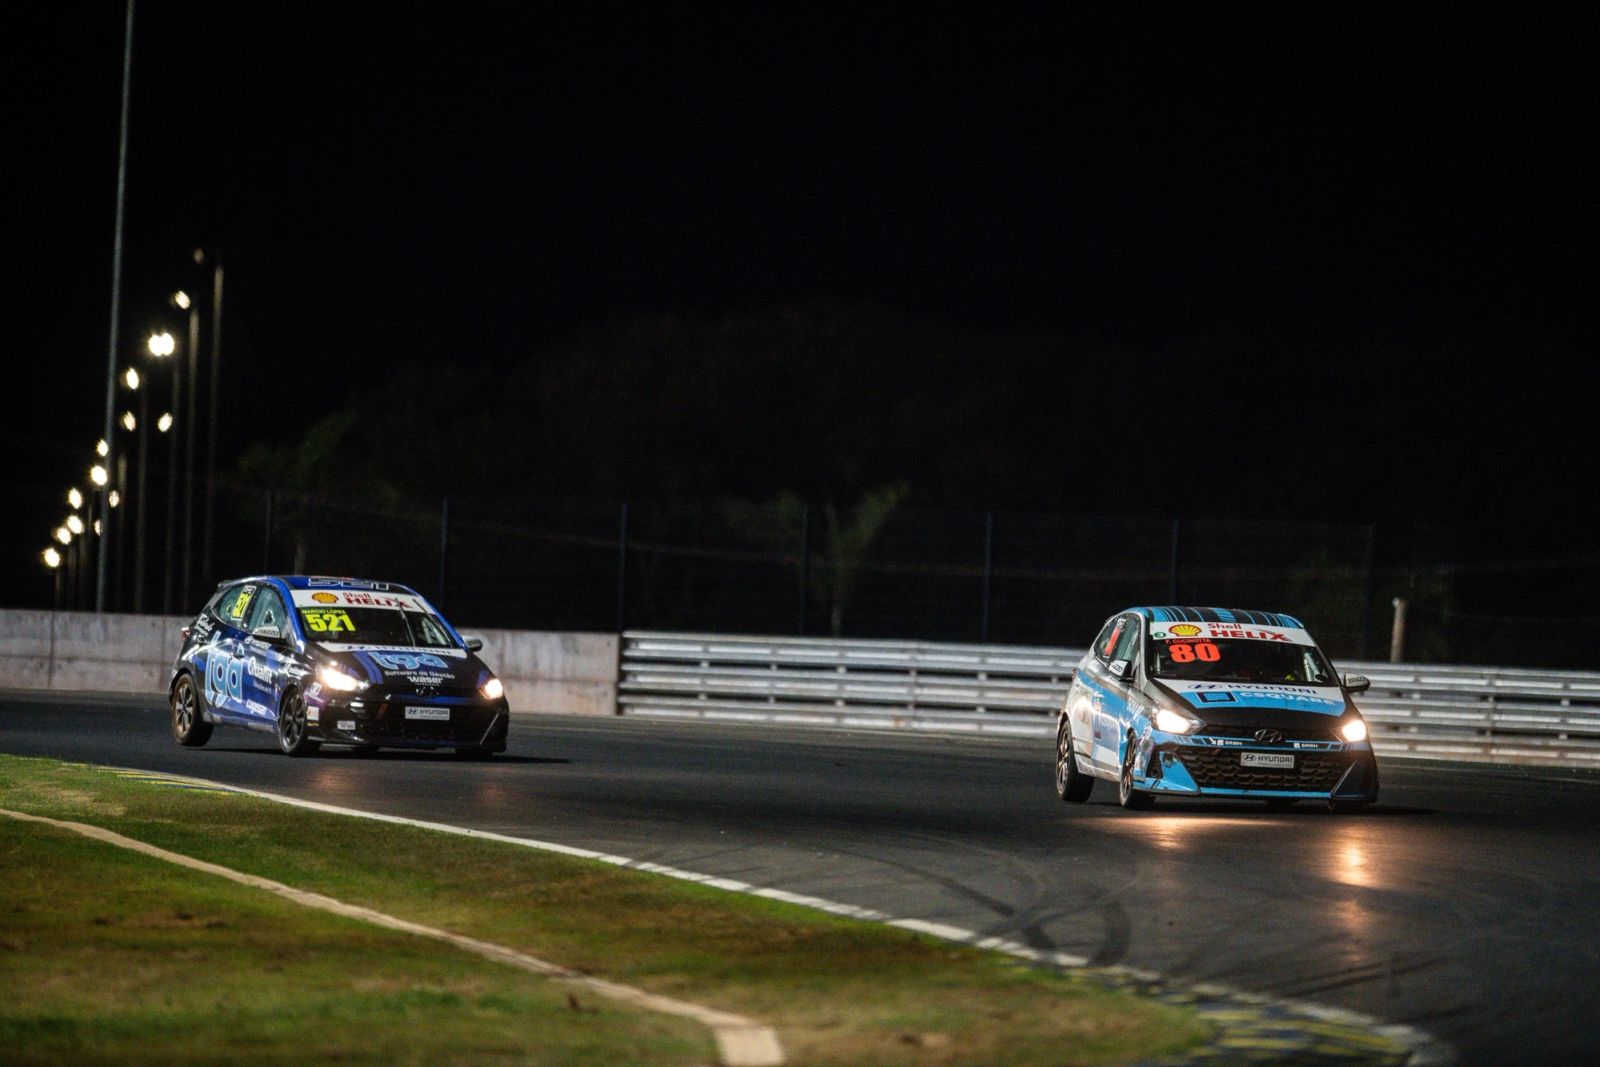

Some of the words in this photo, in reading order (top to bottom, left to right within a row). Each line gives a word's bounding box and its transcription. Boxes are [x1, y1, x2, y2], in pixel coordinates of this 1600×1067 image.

[345, 597, 413, 609] HELIX
[305, 613, 356, 631] 521
[1209, 630, 1293, 643] HELIX
[1168, 643, 1221, 663] 80
[1227, 684, 1317, 695] HYUNDAI
[1240, 692, 1336, 705] CSQUARE
[1257, 755, 1293, 763] HYUNDAI
